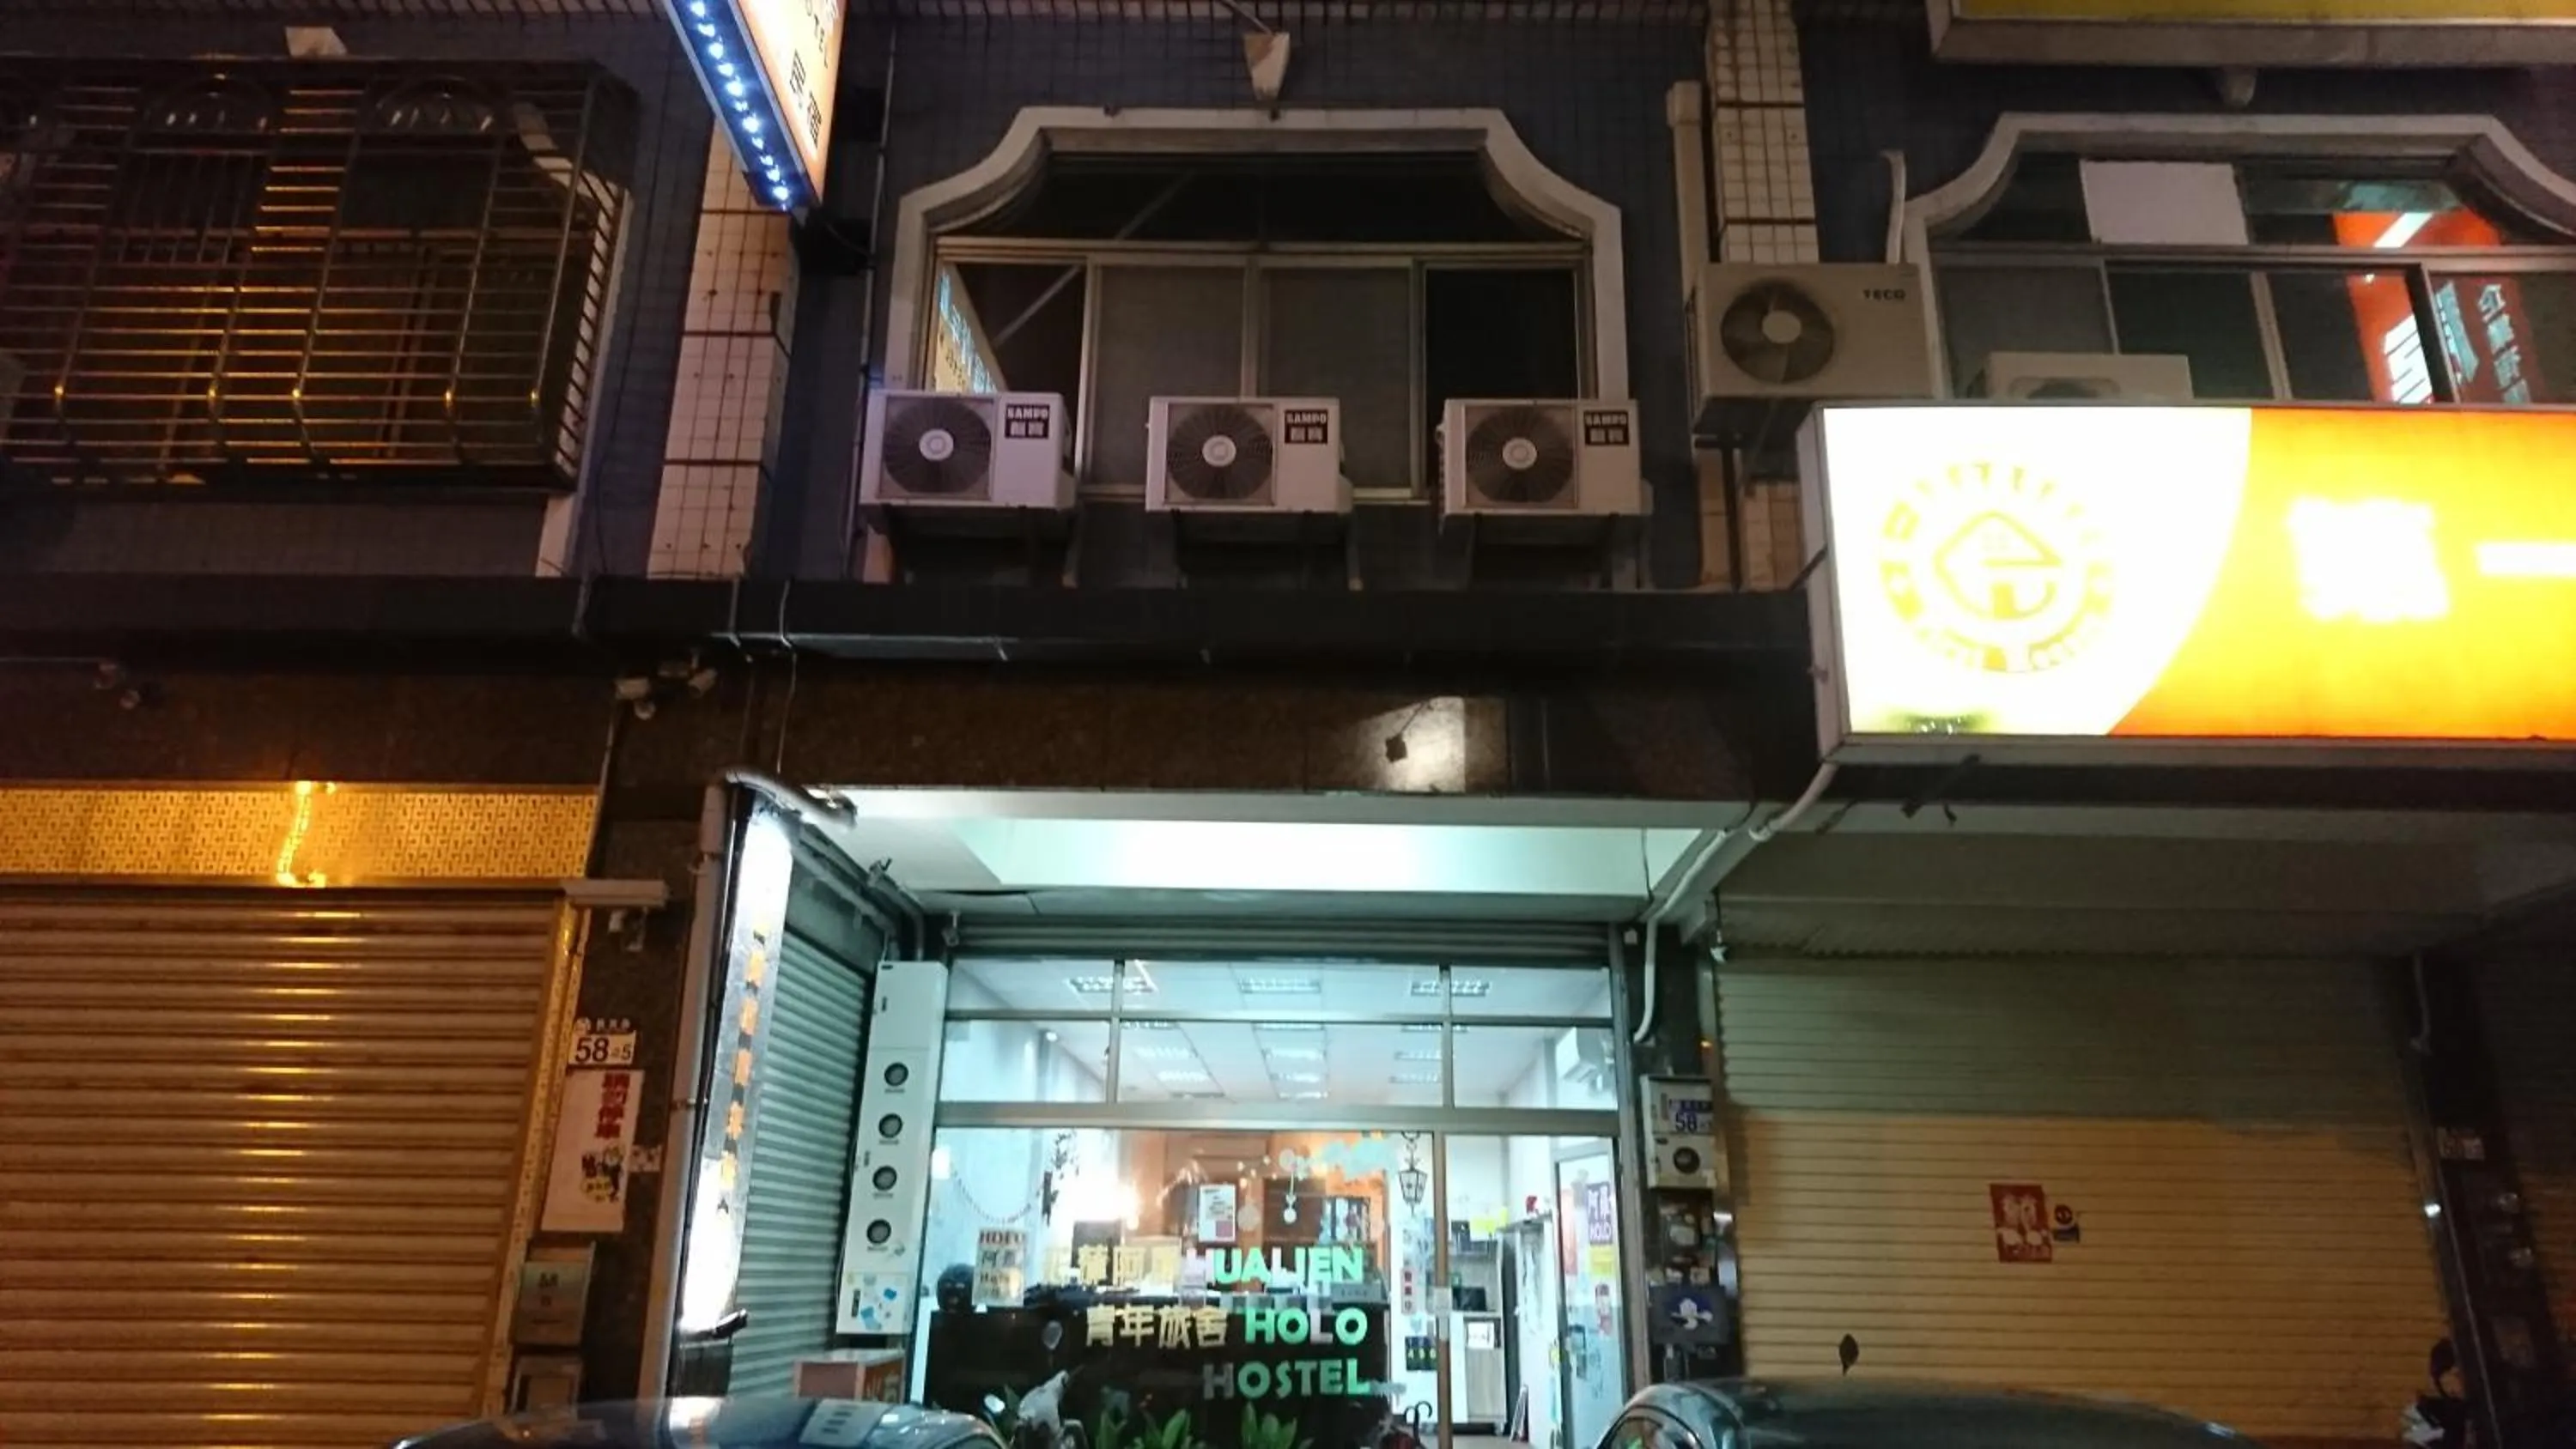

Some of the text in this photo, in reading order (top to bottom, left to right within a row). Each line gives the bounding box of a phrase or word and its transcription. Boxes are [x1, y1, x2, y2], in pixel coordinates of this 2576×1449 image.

[1007, 407, 1048, 420] SAMPO
[1287, 412, 1327, 424] SAMPO
[1181, 1246, 1363, 1283] HUALIEN
[1085, 1302, 1368, 1349] 青年旅舍 HOLO
[1203, 1358, 1370, 1400] HOSTEL
